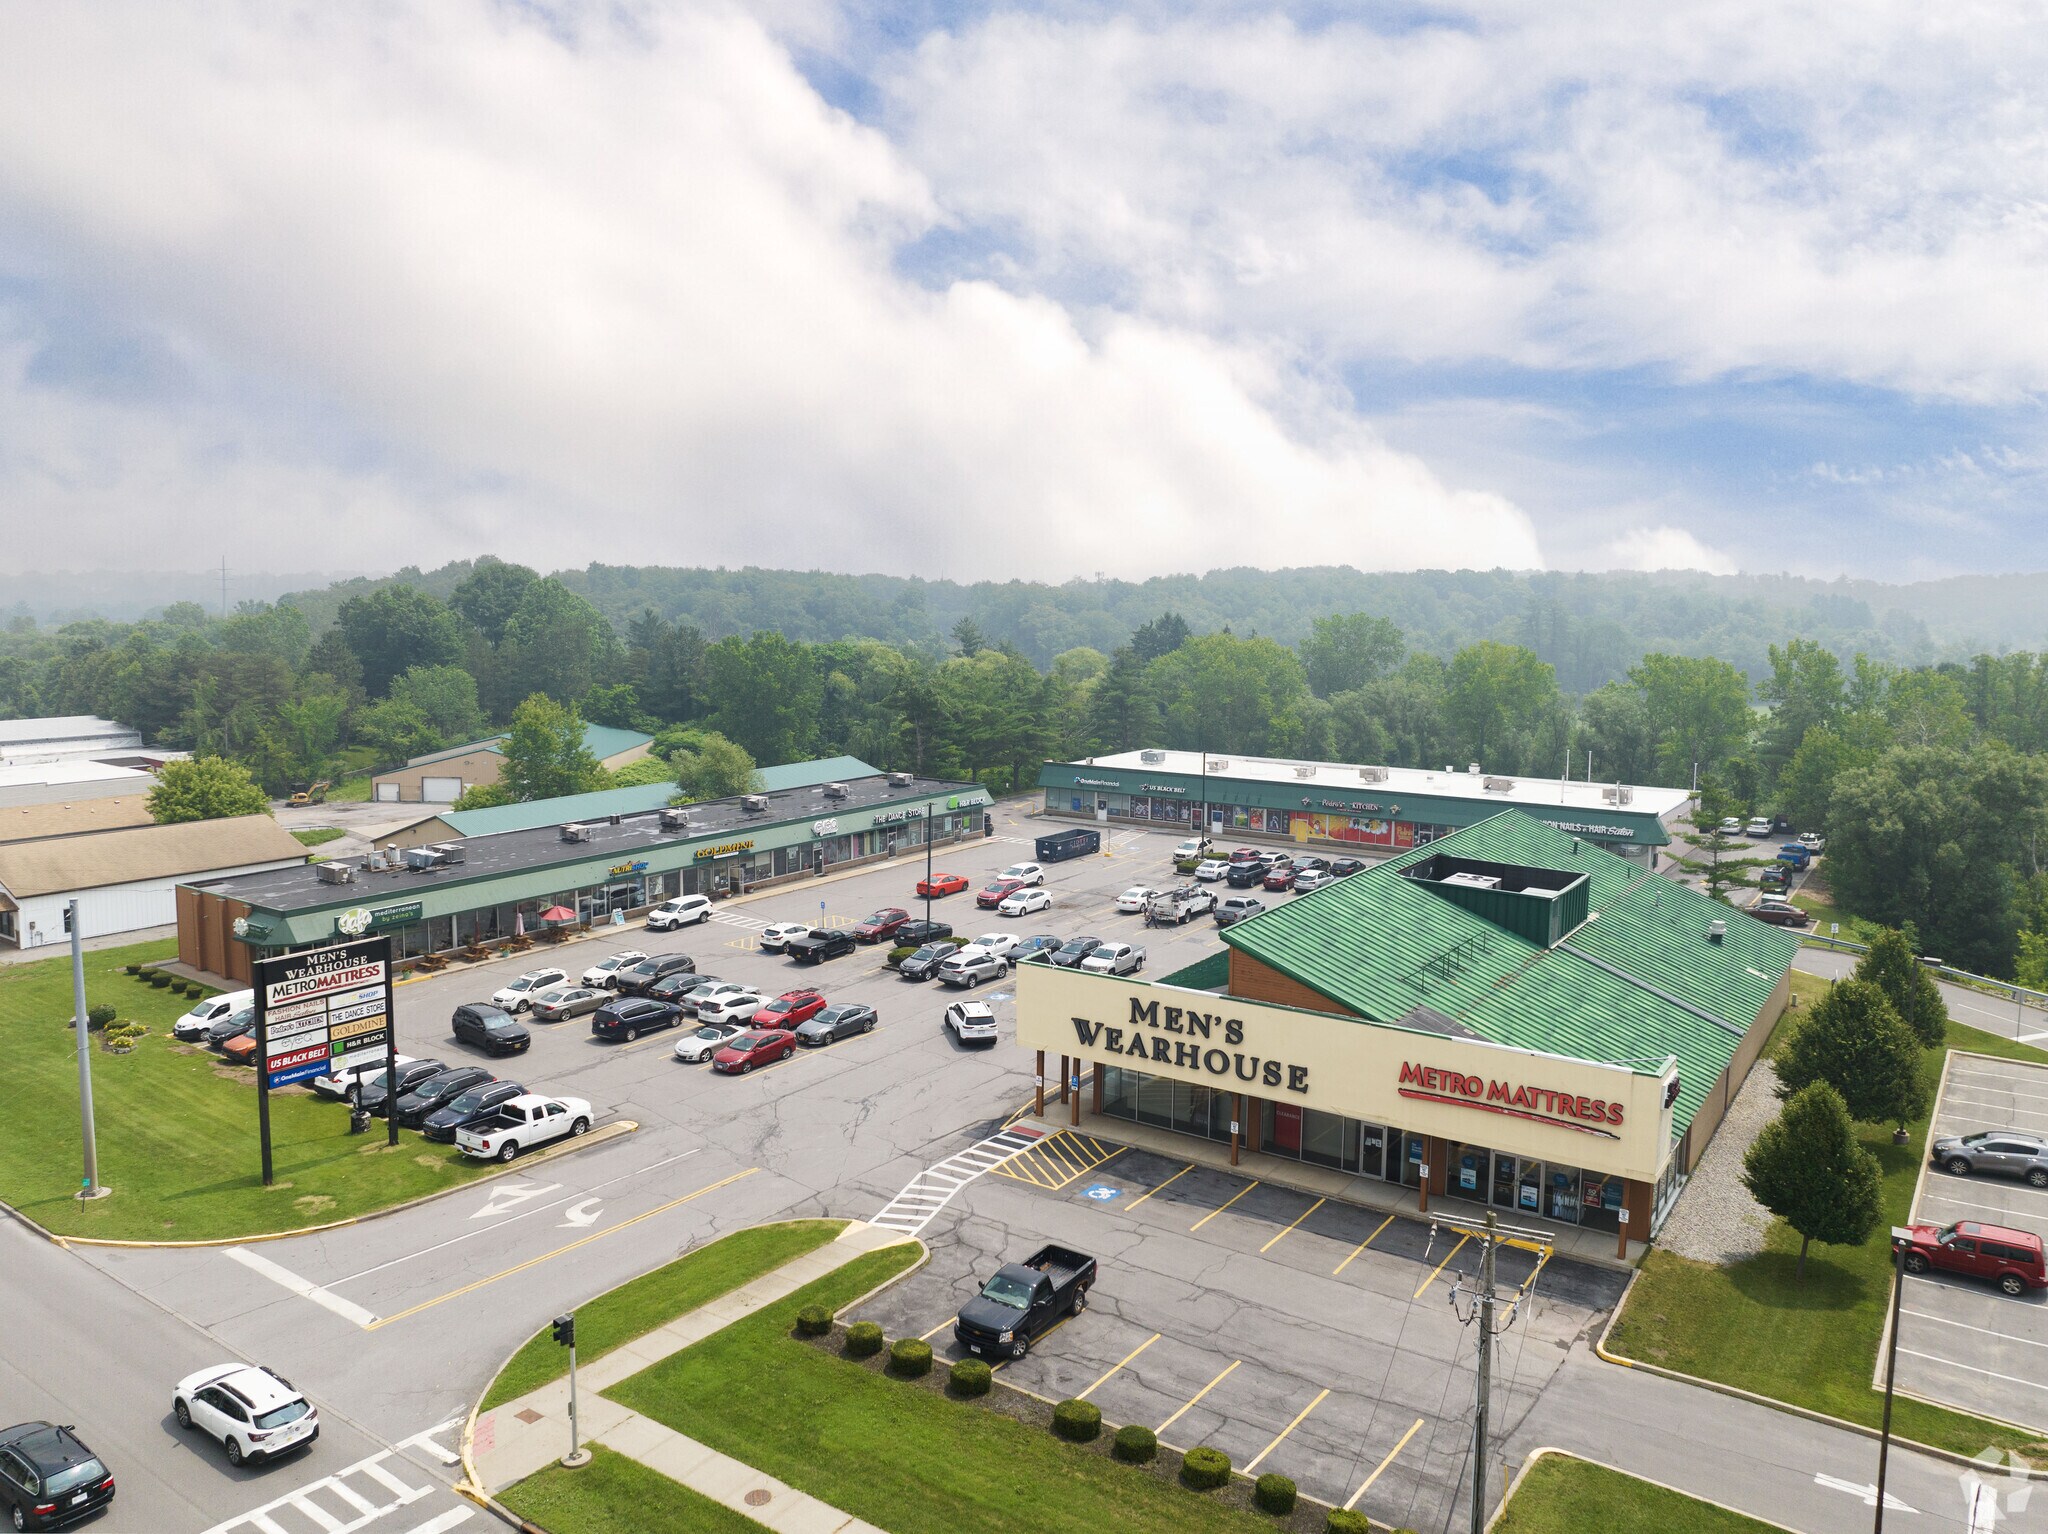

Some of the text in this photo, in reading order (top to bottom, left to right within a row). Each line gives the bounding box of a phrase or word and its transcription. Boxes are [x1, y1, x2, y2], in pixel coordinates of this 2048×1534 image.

[959, 796, 986, 808] H&R BLOCK
[1351, 801, 1379, 811] KITCHEN
[874, 806, 926, 824] THE DANCE STORE
[1560, 821, 1581, 832] NAILS
[1588, 824, 1607, 834] HAIR
[1607, 826, 1634, 837] Salon
[695, 839, 755, 859] GOLDMINE
[374, 904, 421, 917] mediterranean
[307, 949, 347, 966] MEN'S
[285, 955, 368, 980] WEARHOUSE
[267, 1004, 301, 1017] FASHION
[303, 998, 325, 1009] NAILS
[331, 1002, 385, 1023] THE DANCE STORE
[270, 1023, 295, 1036] Pedro's
[295, 1015, 324, 1029] KITCHEN
[275, 1013, 292, 1022] HAIR
[332, 1016, 385, 1037] GOLDMINE
[1129, 997, 1244, 1046] MEN'S
[346, 1033, 385, 1049] H&R BLOCK
[270, 1047, 327, 1069] US BLACK BELT
[1071, 1017, 1310, 1095] WEARHOUSE
[1398, 1061, 1484, 1098] METRO
[1487, 1079, 1624, 1127] MATTRESS
[1276, 1110, 1300, 1120] CLEARANCE
